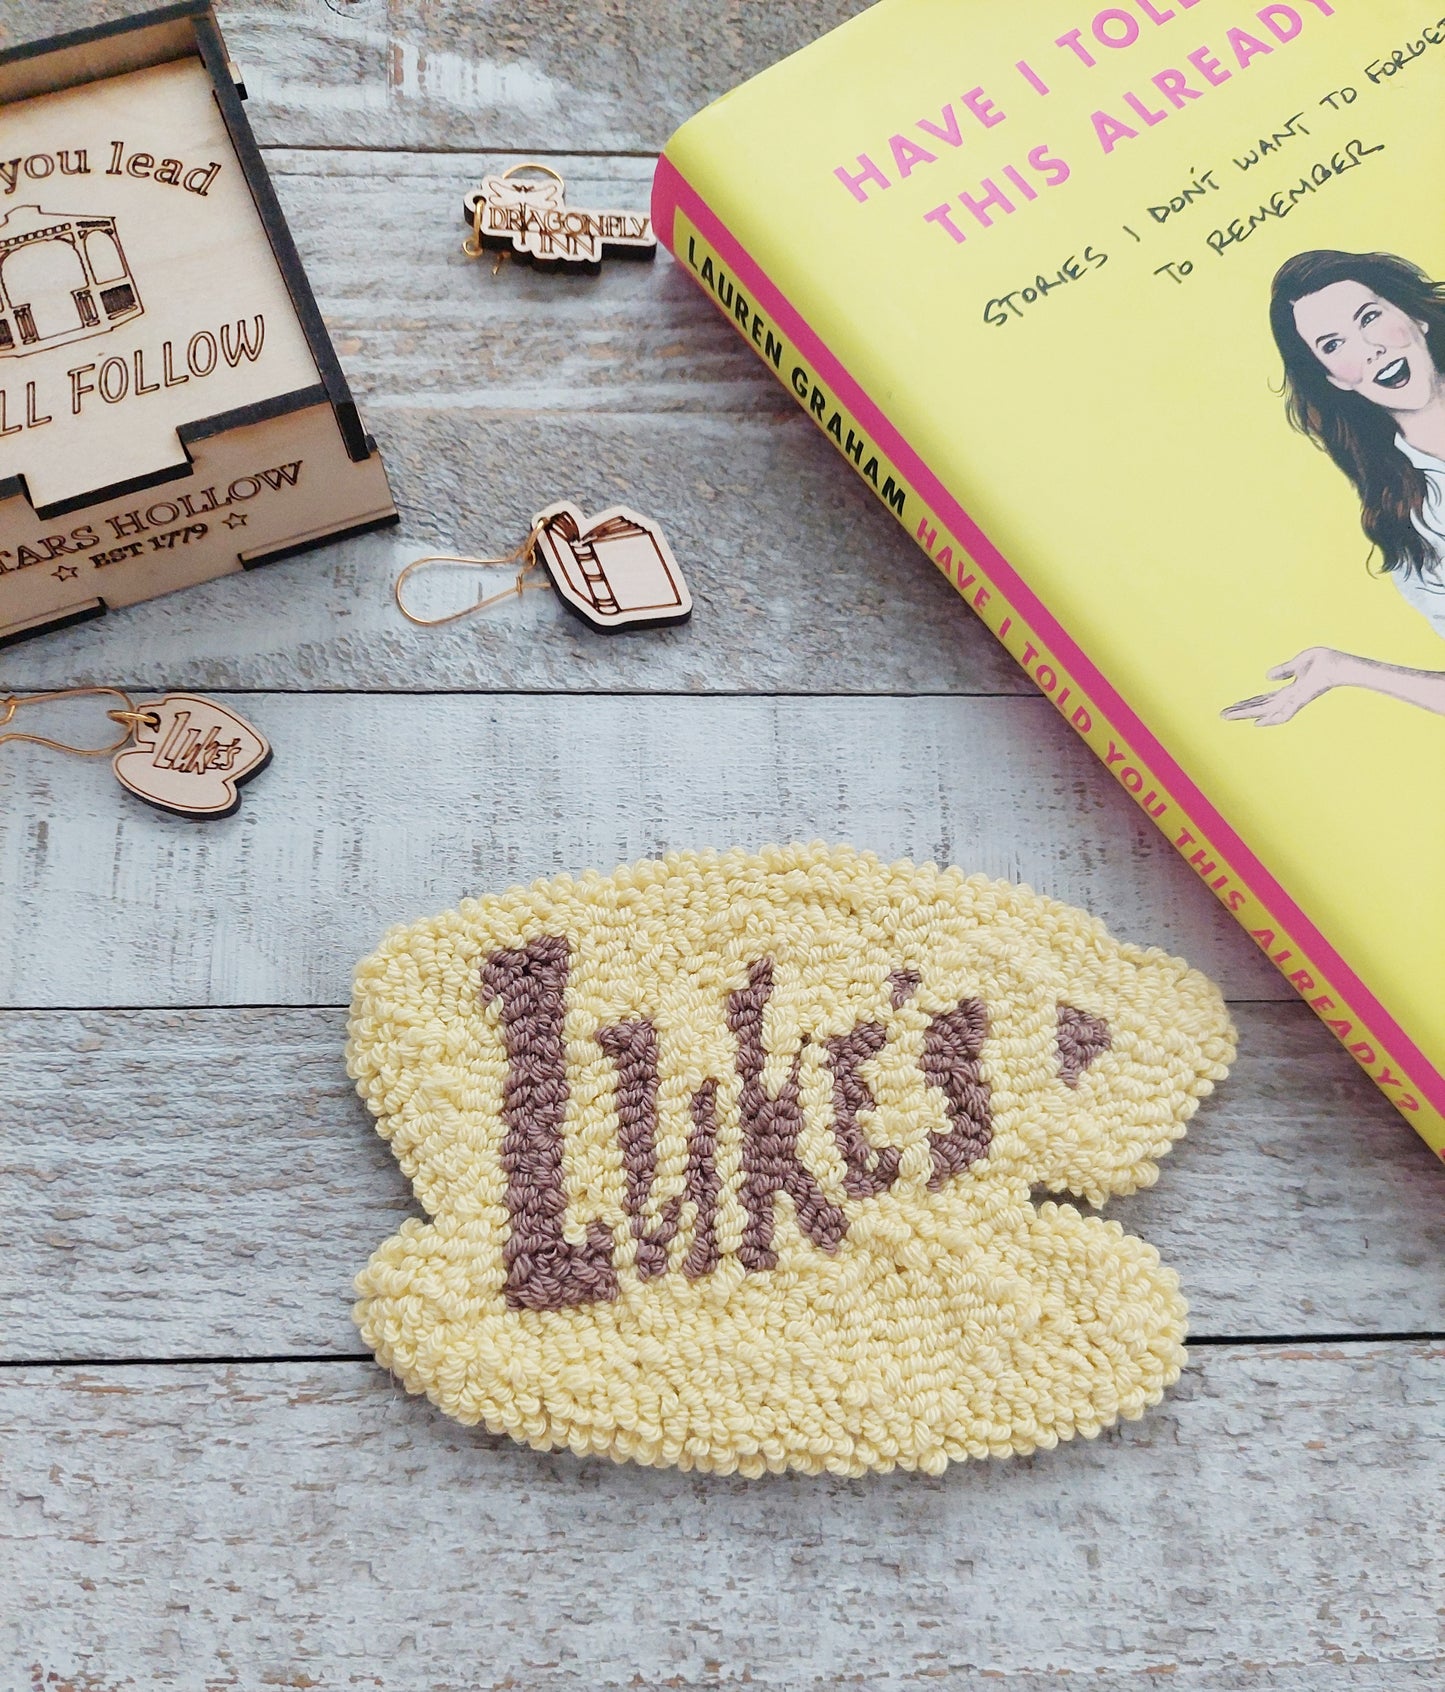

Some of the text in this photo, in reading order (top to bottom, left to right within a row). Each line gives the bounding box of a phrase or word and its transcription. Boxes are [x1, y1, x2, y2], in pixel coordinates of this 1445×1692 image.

[0, 141, 222, 197] you lead
[833, 86, 1006, 204] HAVE
[1015, 60, 1050, 96] I
[983, 17, 1445, 327] STORIES I DON'T WANT TO FORGE
[488, 207, 649, 240] DRAGONFLY
[540, 232, 595, 256] INN
[924, 144, 1071, 245] THIS
[1154, 139, 1385, 284] TO REMEMBER
[67, 314, 265, 415] FOLLOW
[89, 522, 209, 569] EST 1779
[105, 459, 304, 540] HOLLOW
[687, 236, 1420, 1113] LAUREN GRAHAM HAVE I TOLD YOU THIS ALREADY?
